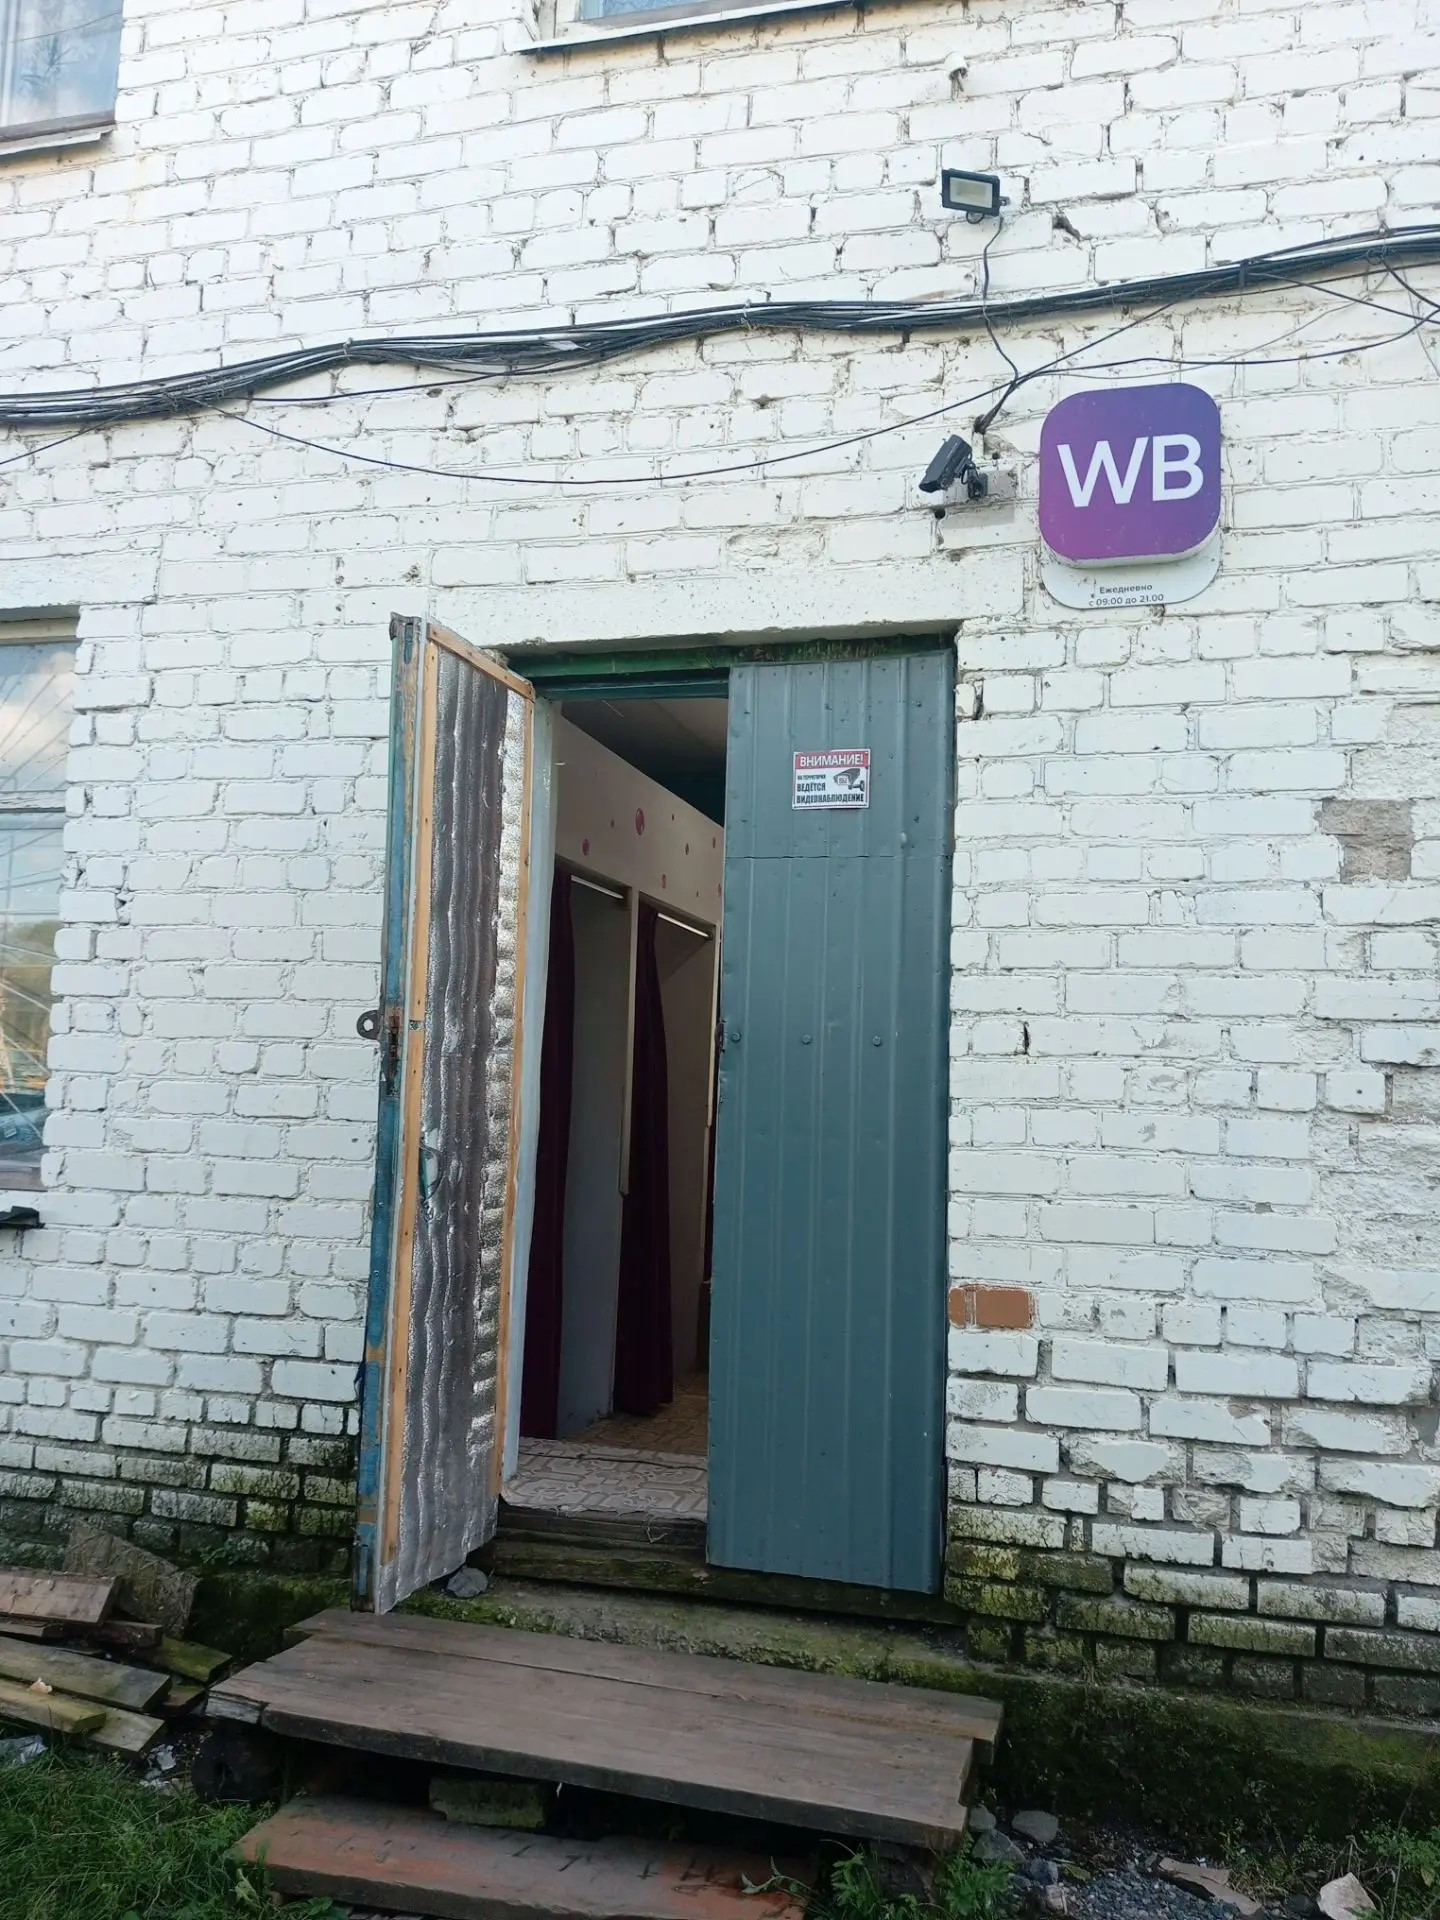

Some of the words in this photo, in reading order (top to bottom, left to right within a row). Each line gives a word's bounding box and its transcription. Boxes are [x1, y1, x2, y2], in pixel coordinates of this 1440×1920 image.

[1056, 433, 1204, 508] WB
[1099, 584, 1153, 594] Ежедневно
[800, 754, 864, 767] ВНИМАНИЕ!
[797, 793, 864, 804] ВИДЕОНАБЛЮДЕНИЕ
